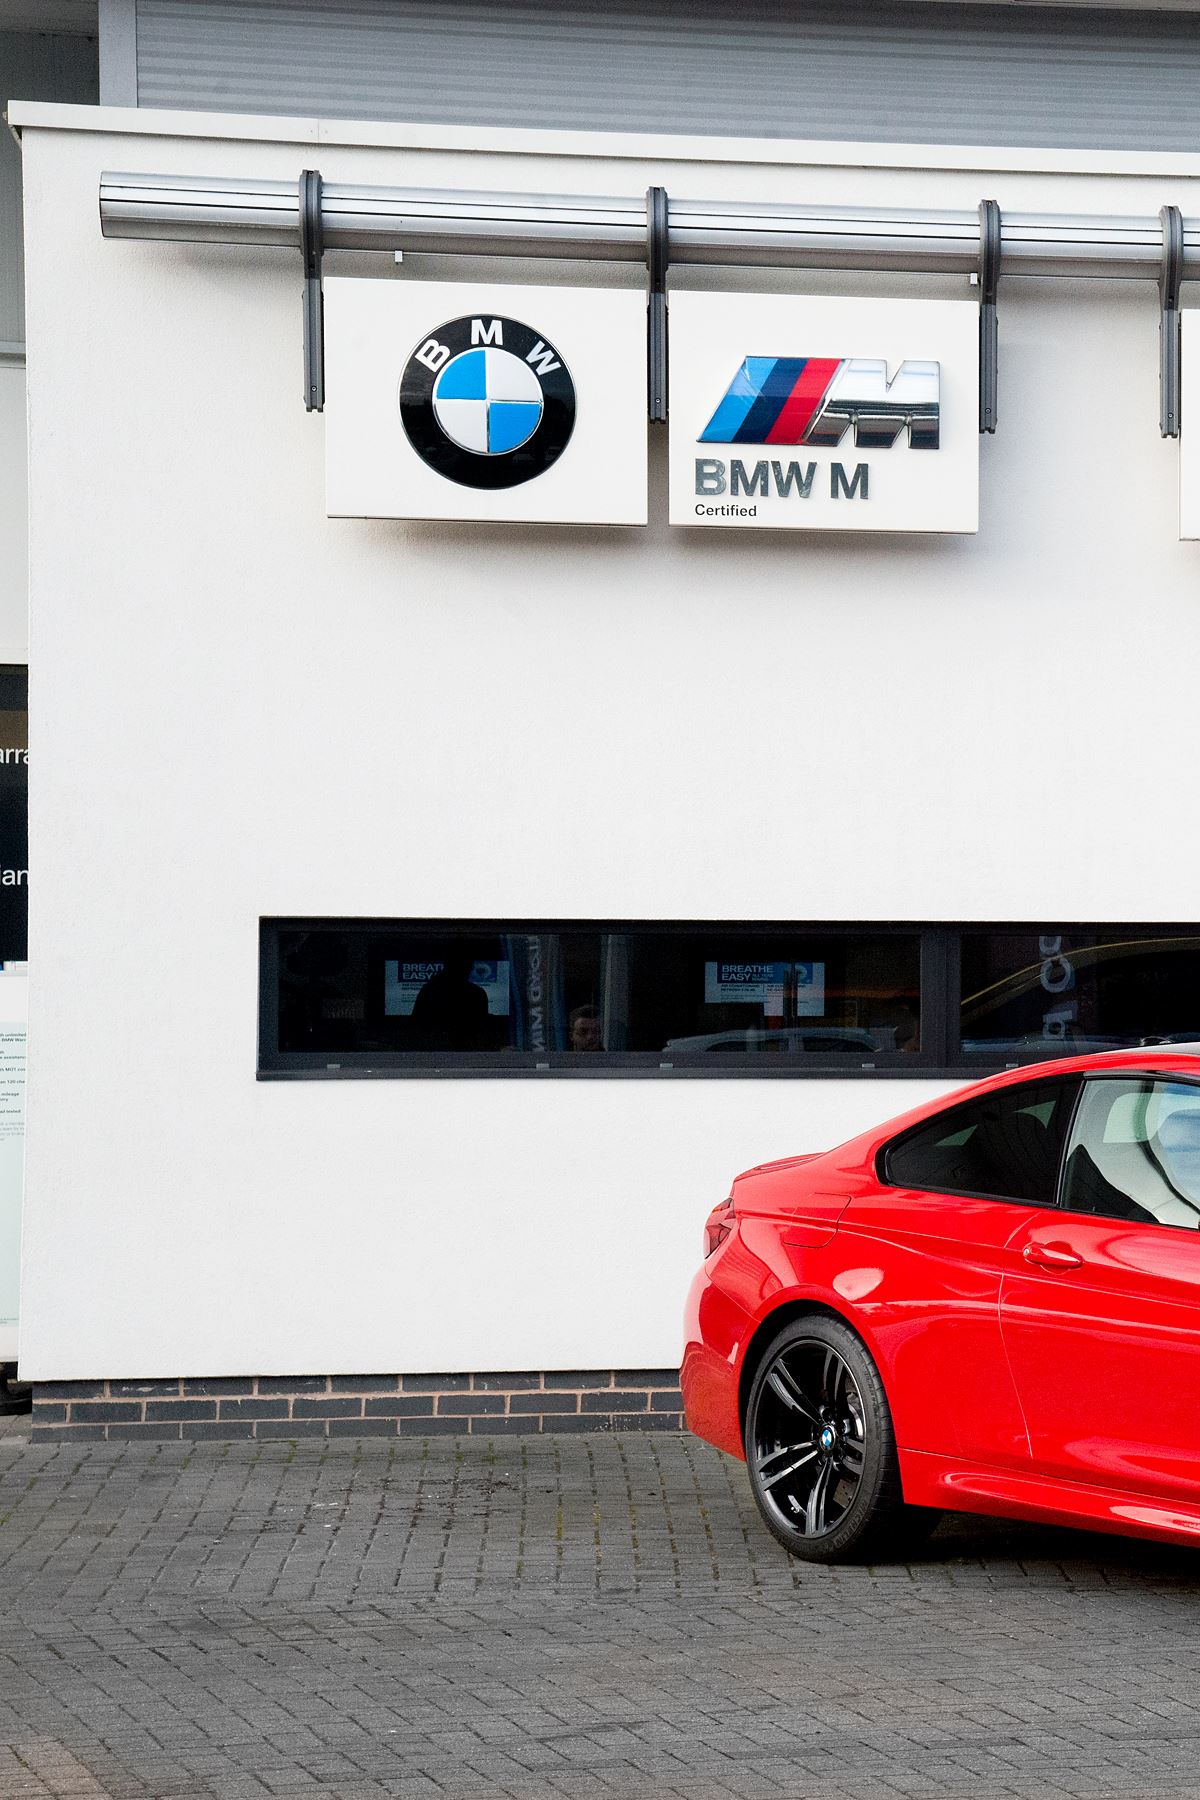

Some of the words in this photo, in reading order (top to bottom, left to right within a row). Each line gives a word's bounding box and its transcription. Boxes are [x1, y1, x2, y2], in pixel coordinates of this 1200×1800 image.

[418, 318, 562, 377] BMW
[695, 458, 818, 498] BMW
[830, 462, 869, 499] M
[694, 504, 757, 516] Certified
[722, 965, 774, 973] BREATHE
[402, 972, 433, 980] EASY
[721, 973, 751, 981] EASY
